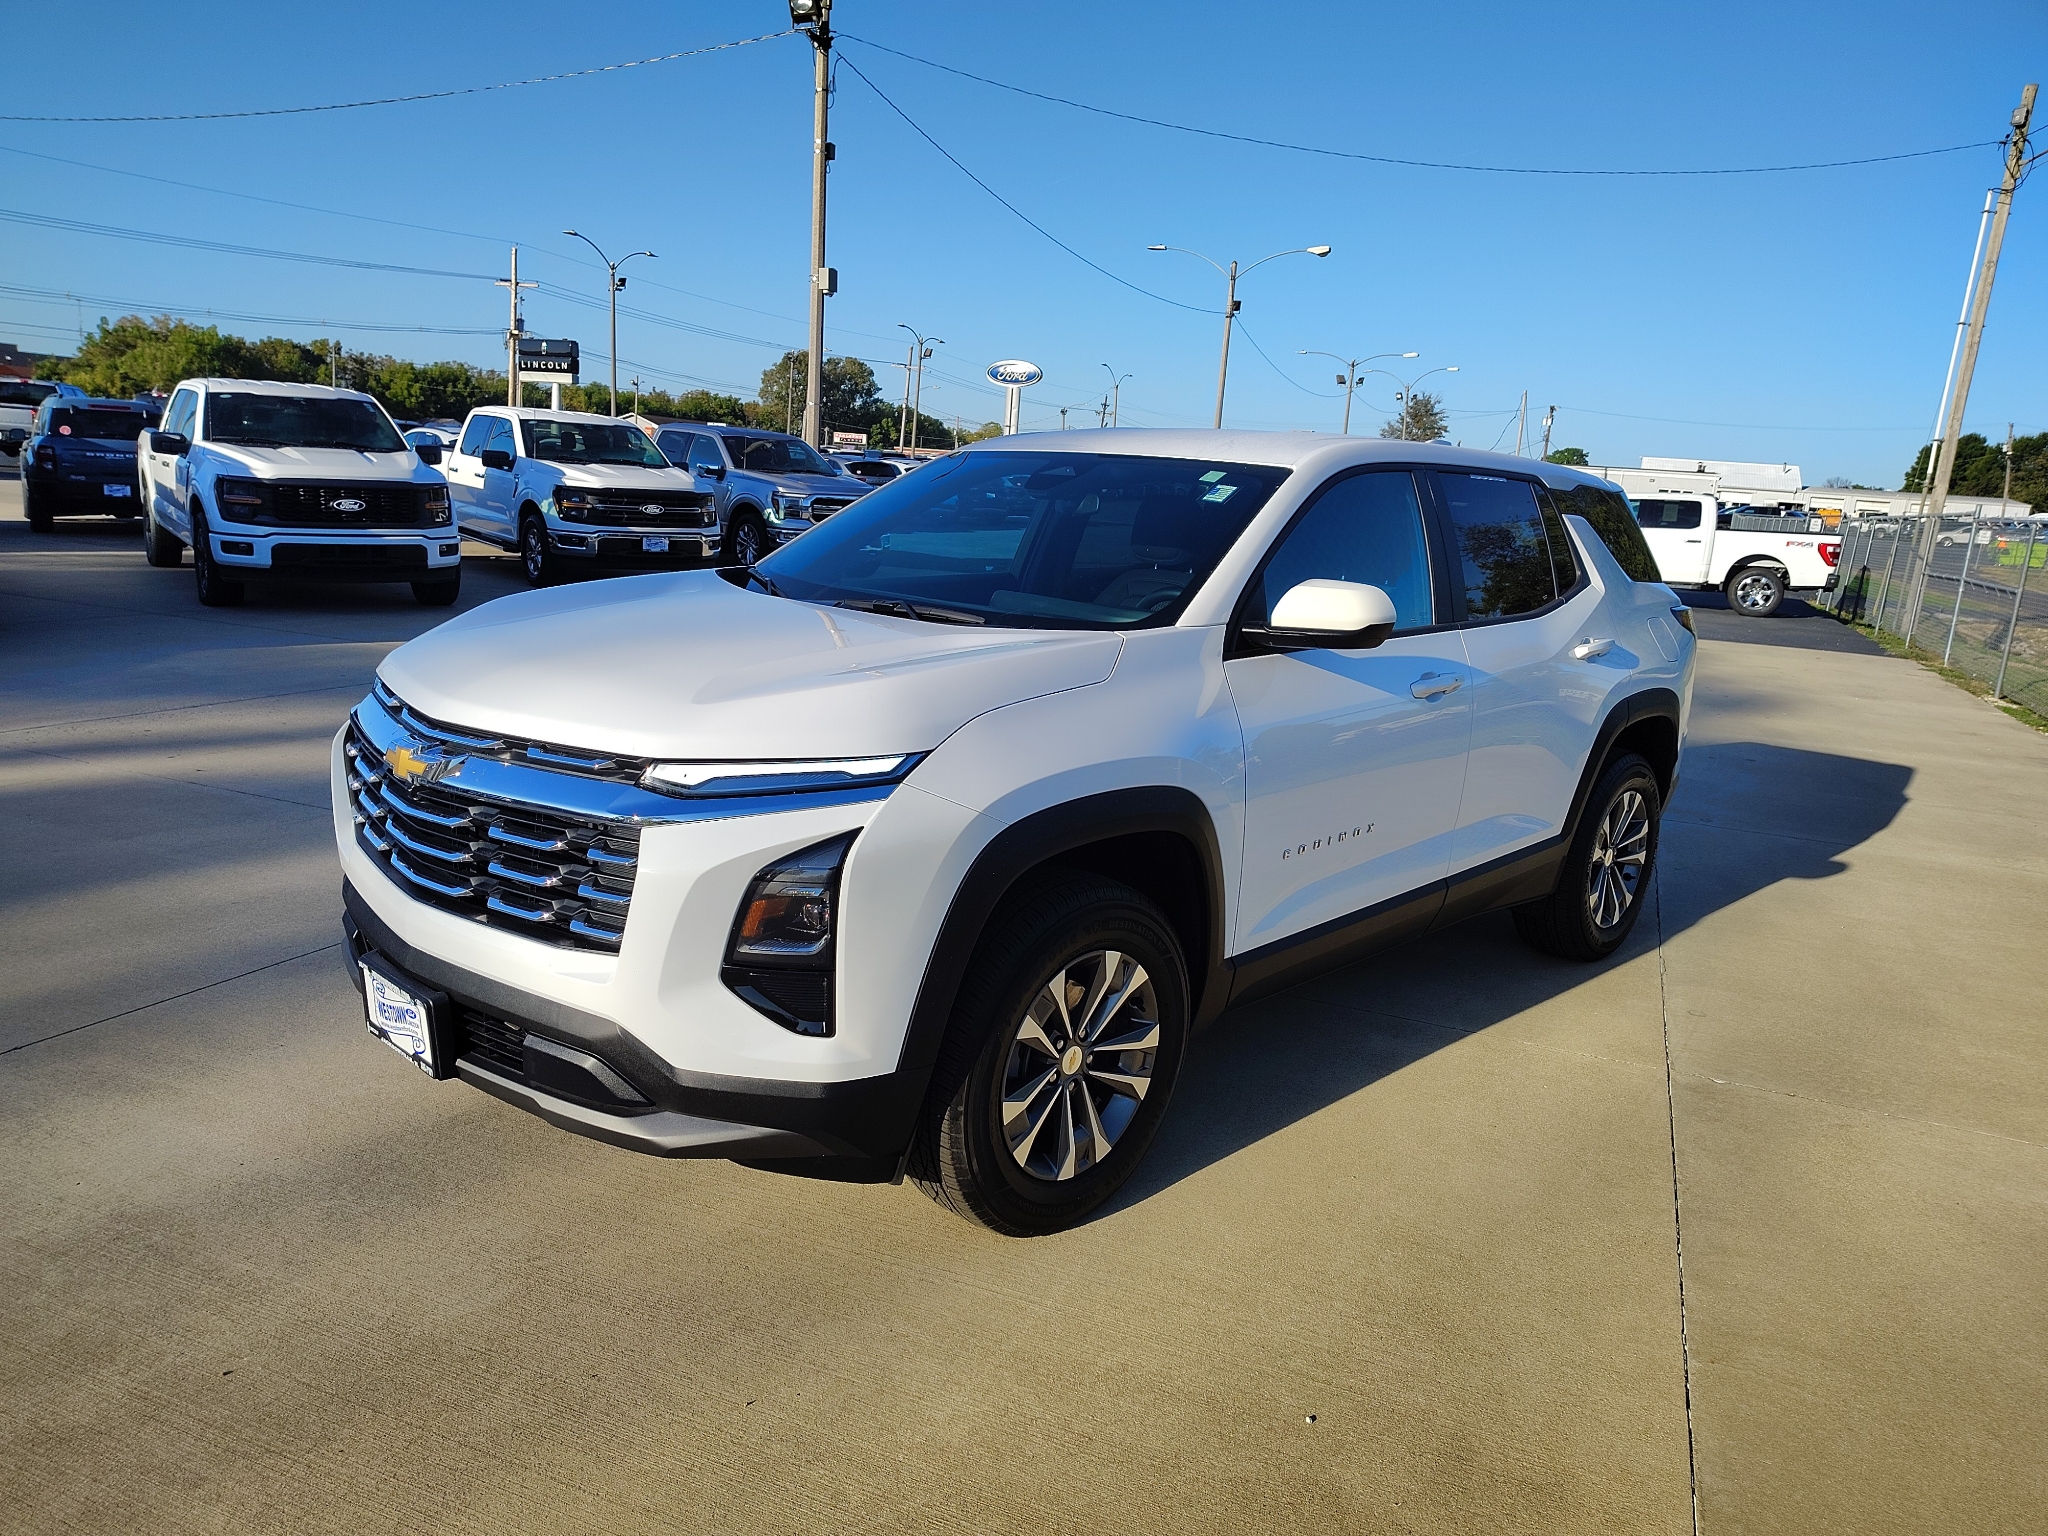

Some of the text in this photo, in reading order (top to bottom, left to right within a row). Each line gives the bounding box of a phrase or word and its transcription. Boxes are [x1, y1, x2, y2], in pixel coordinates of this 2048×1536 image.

[521, 360, 568, 369] LINCOLN
[1283, 823, 1375, 859] EQUINOX
[377, 1001, 407, 1025] WESTOWN
